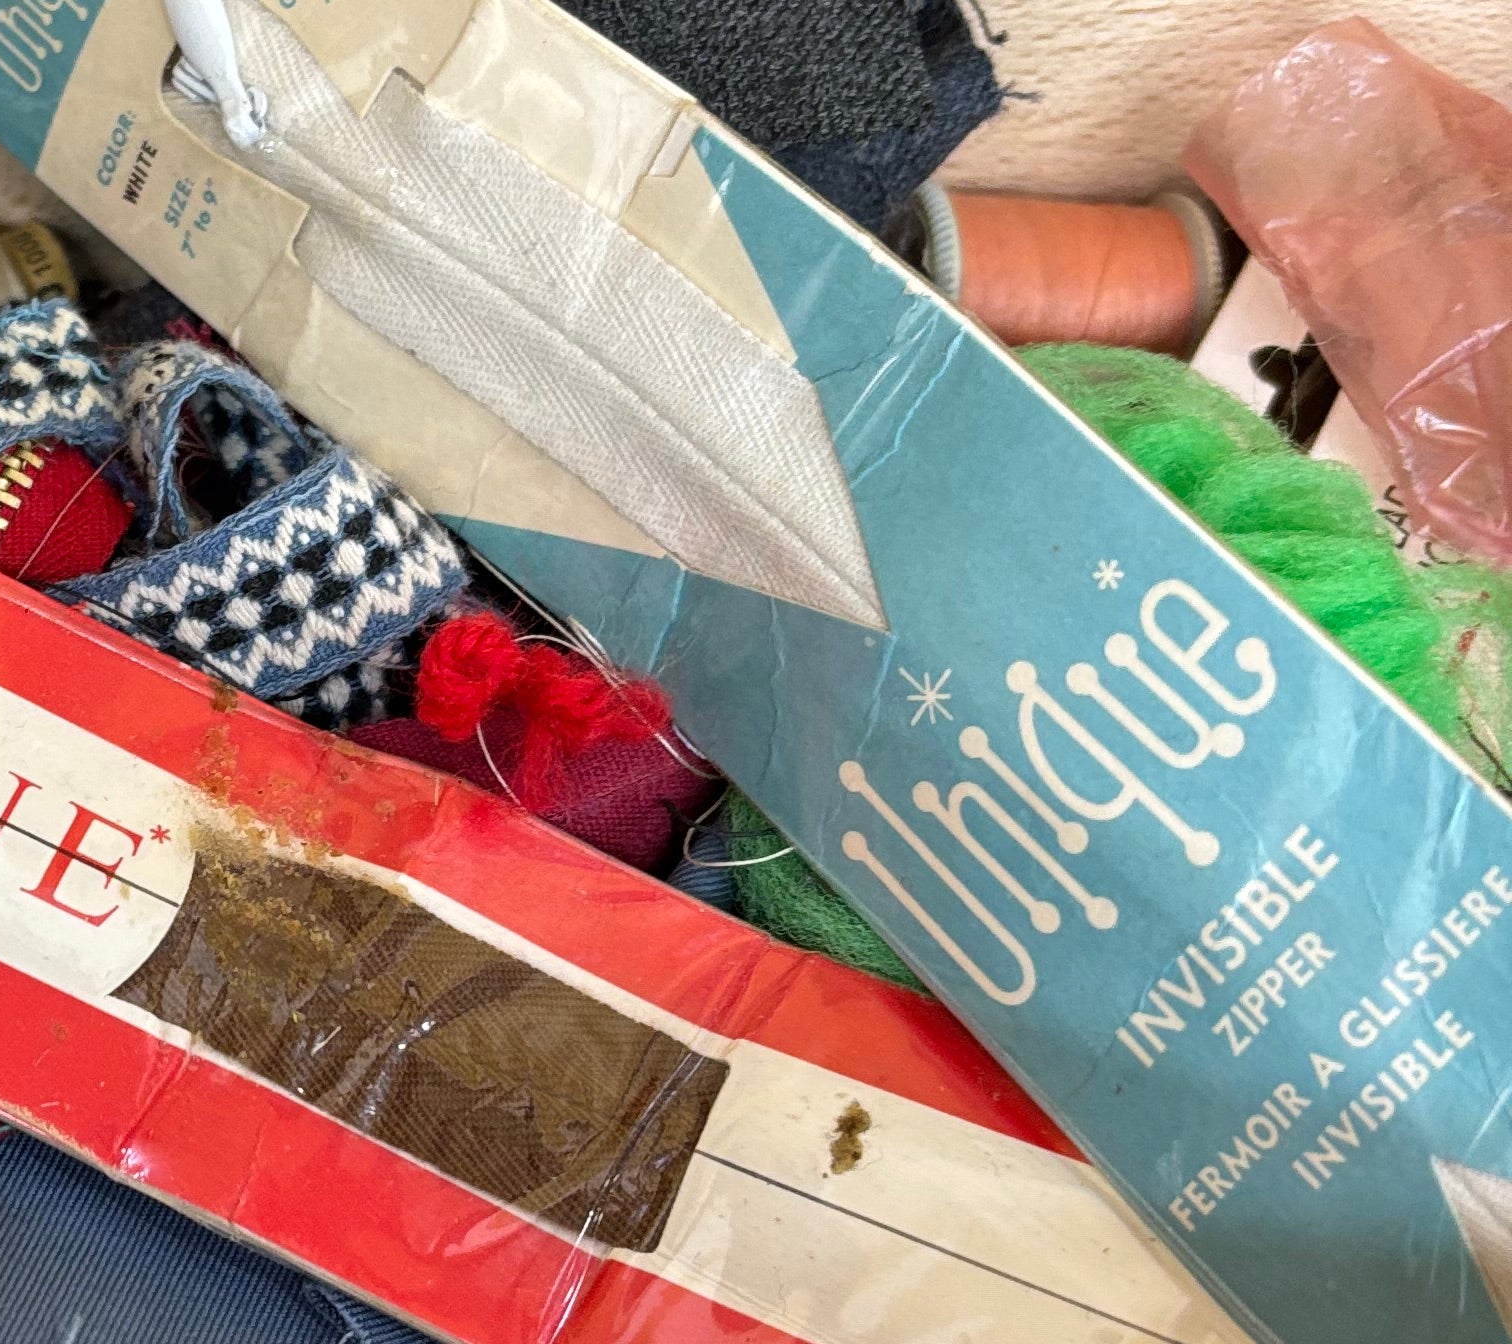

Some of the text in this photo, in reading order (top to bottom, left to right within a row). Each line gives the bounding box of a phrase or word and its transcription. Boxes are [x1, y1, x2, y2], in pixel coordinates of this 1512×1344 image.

[122, 139, 159, 206] WHITE
[1114, 823, 1340, 1068] INVISIBLE
[1211, 930, 1336, 1058] ZIPPER
[1168, 864, 1512, 1233] FERMOIR A GLISSIERE
[1291, 1010, 1476, 1191] INVISIBLE
